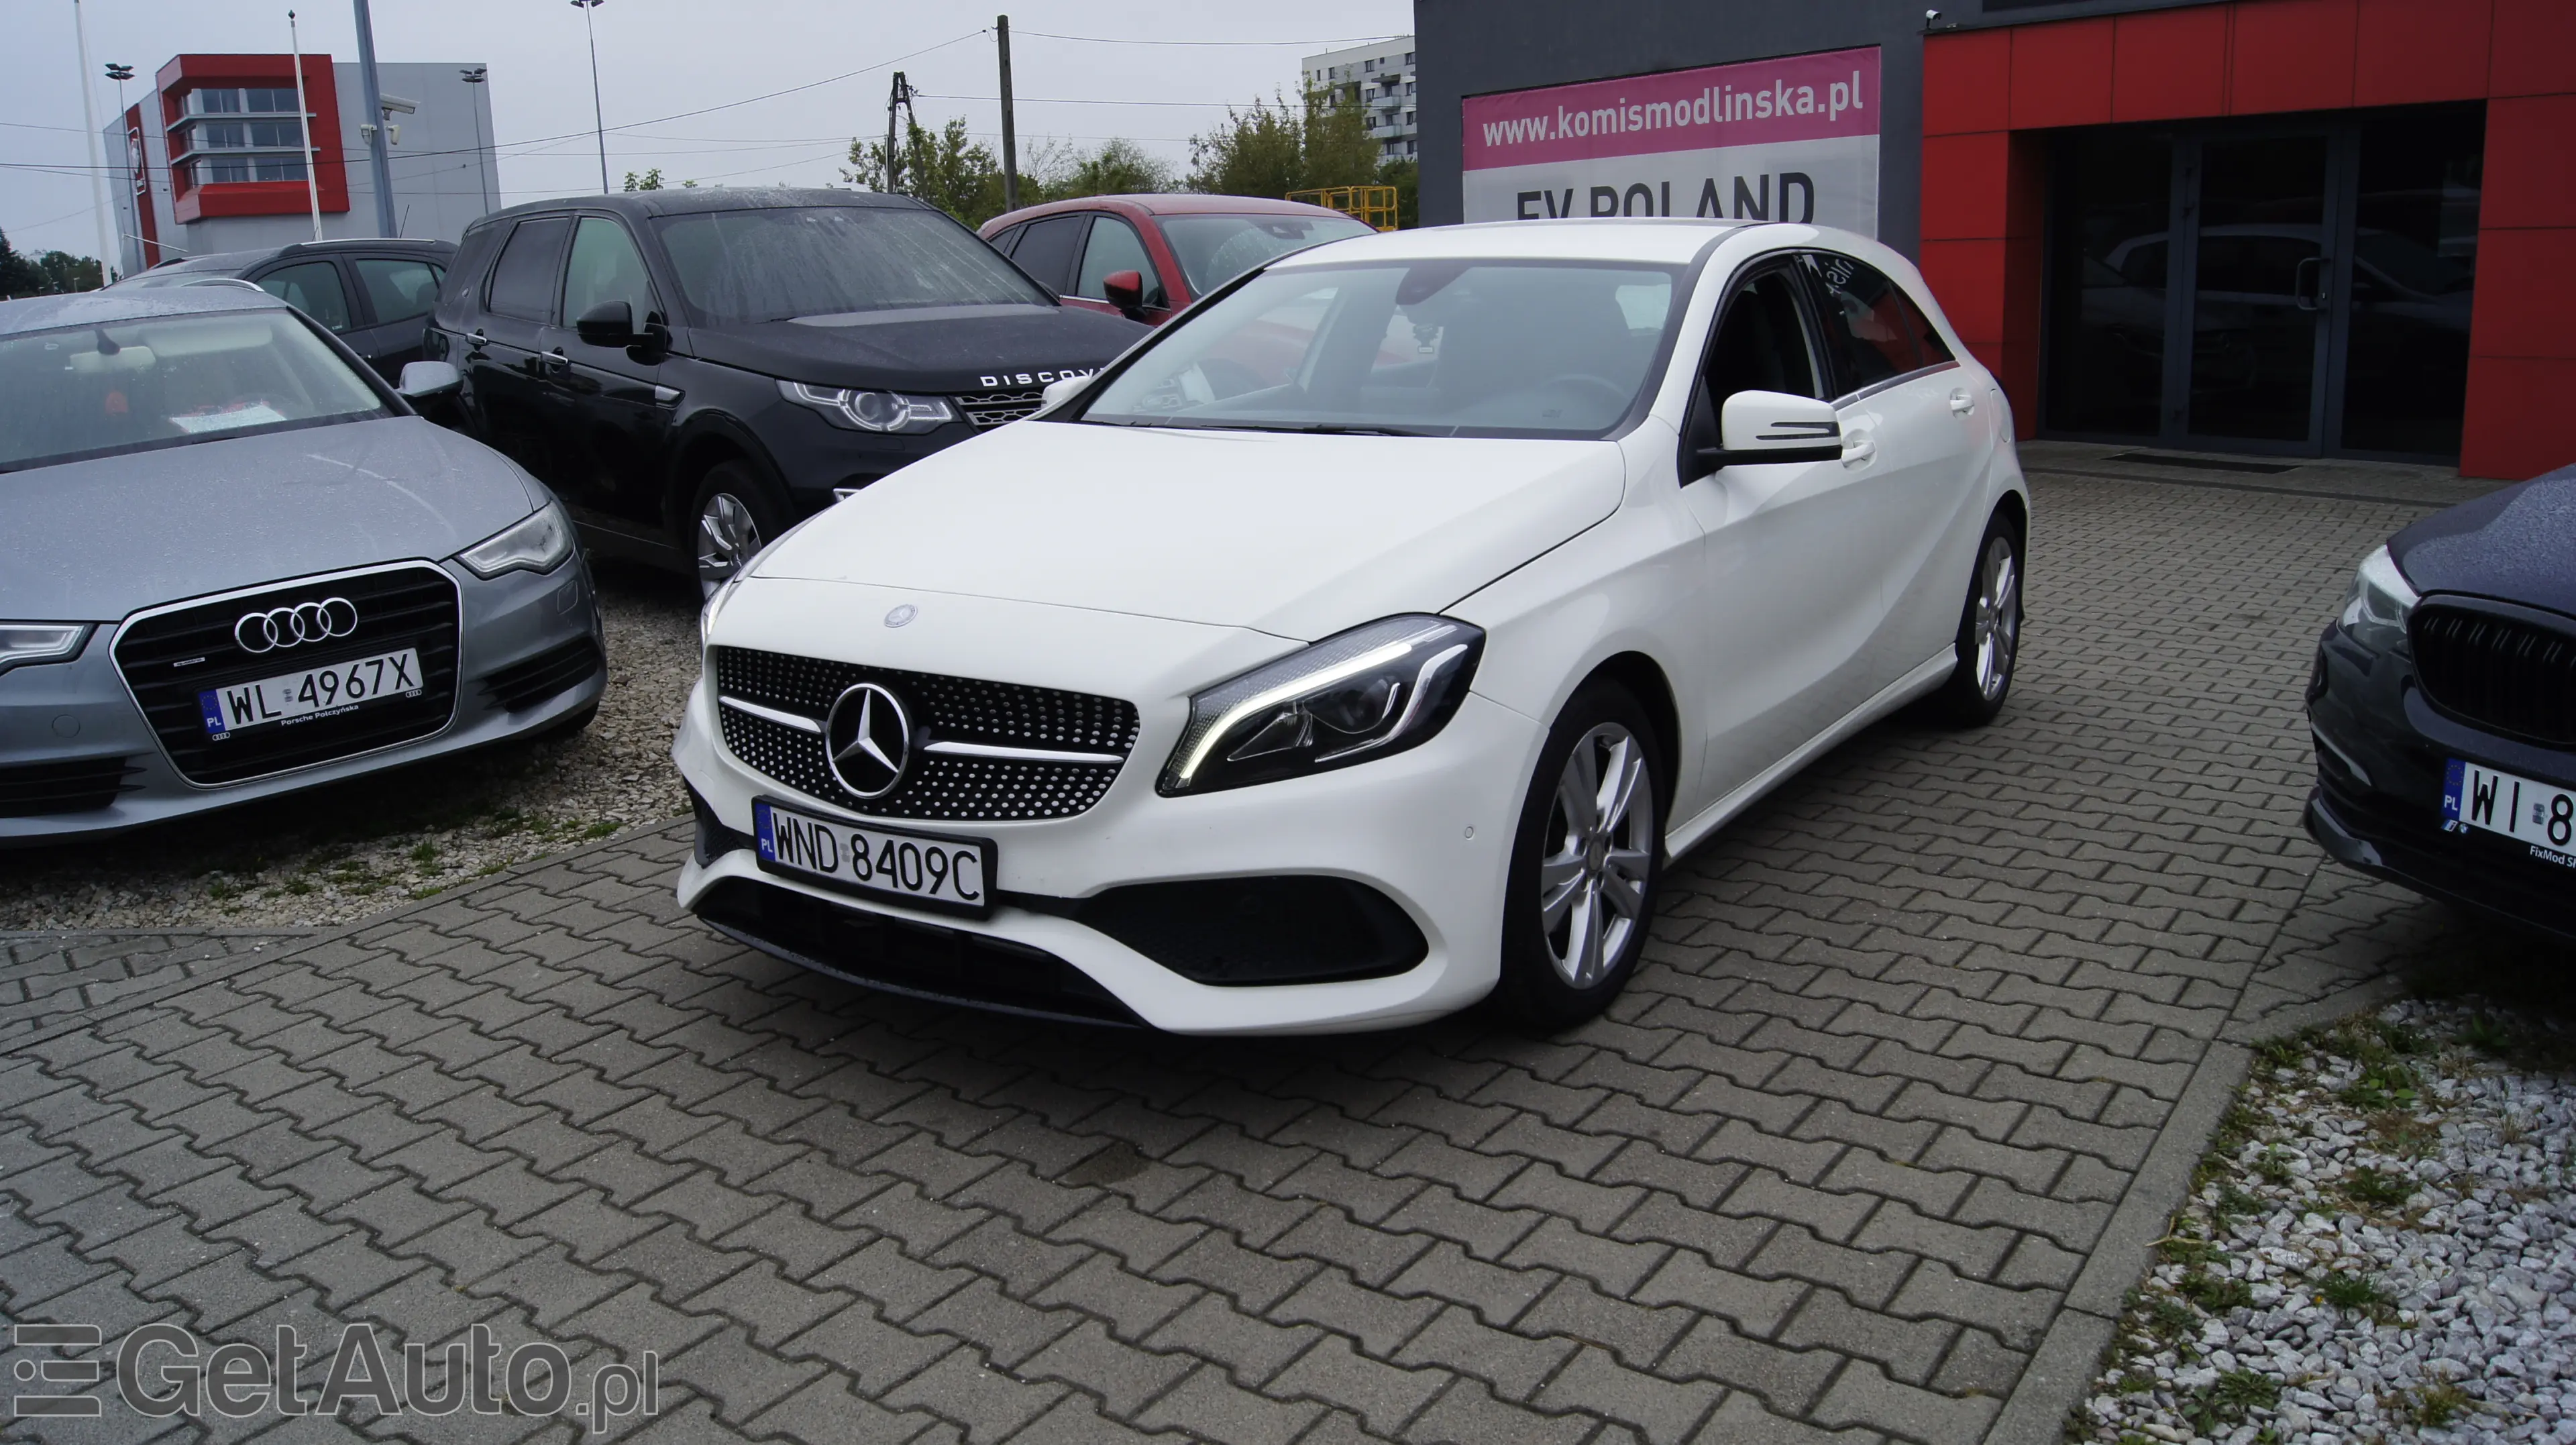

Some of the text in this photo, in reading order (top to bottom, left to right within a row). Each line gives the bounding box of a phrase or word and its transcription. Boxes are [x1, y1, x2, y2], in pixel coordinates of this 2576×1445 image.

[1483, 70, 1863, 146] www.komismodlinska.pl
[980, 368, 1106, 386] DISCOV
[227, 653, 414, 725] WL 4967X
[207, 716, 221, 728] PL
[281, 714, 313, 726] Porsche
[2444, 794, 2458, 811] PL
[2471, 769, 2574, 846] WI 8
[761, 838, 773, 853] PL
[2530, 845, 2565, 865] FixMod
[773, 812, 980, 900] WND 8409C
